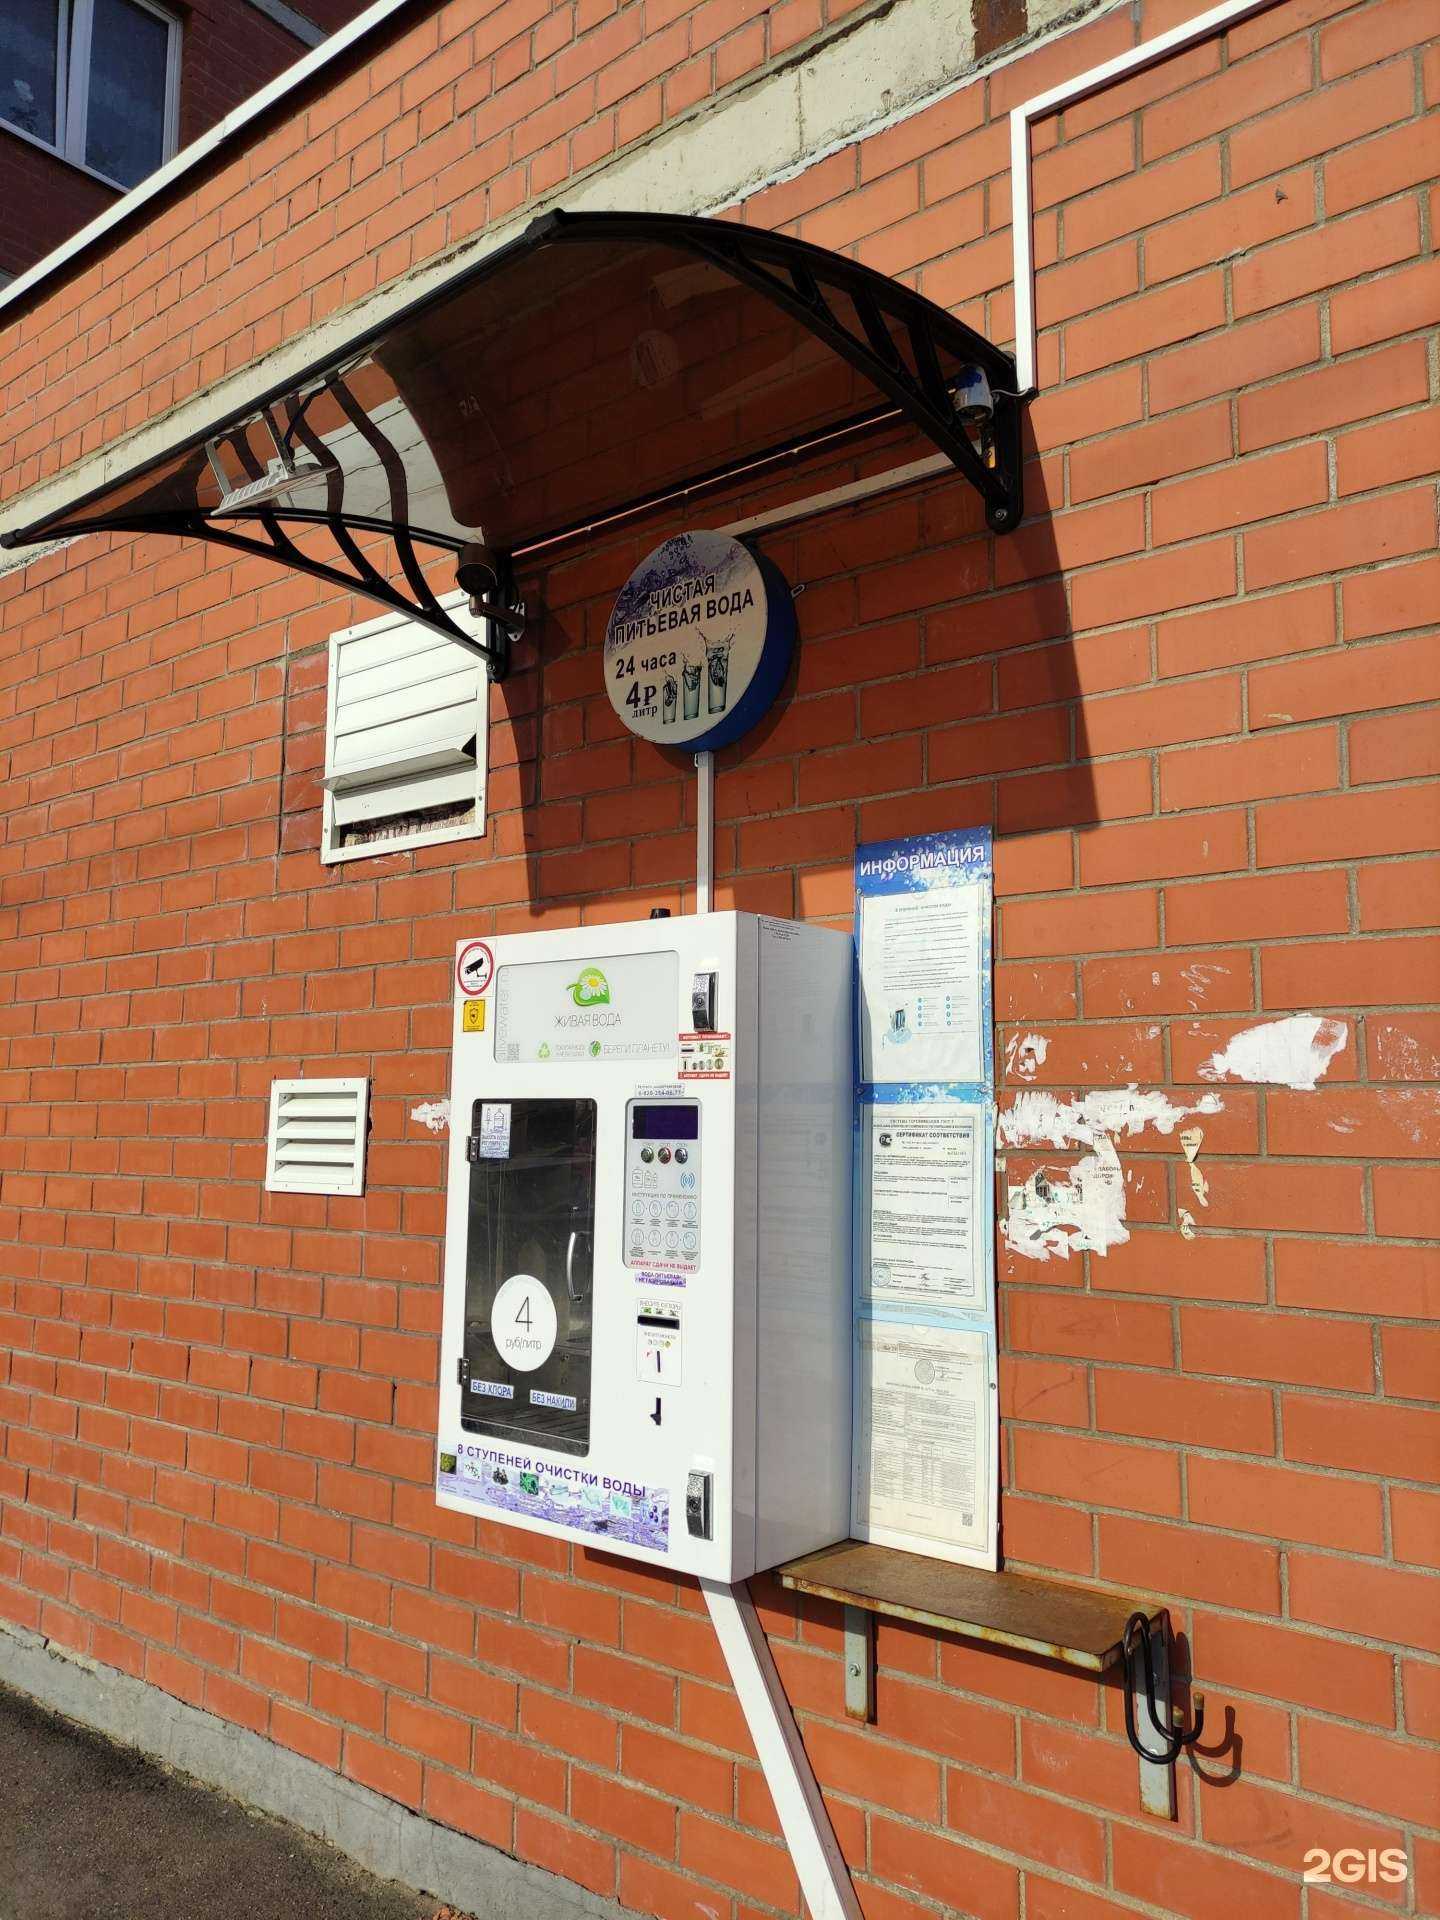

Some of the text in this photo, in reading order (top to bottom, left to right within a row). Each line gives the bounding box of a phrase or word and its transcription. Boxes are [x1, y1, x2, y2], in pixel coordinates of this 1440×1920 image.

[651, 575, 715, 610] ЧИСТАЯ
[614, 589, 754, 645] ПИТЬЕВАЯ ВОДА
[615, 652, 677, 679] 24 часа
[632, 705, 658, 718] литр
[860, 845, 985, 876] ИНФОРМАЦИЯ
[555, 1013, 622, 1028] ЖИВАЯ ВОДА
[515, 1296, 533, 1332] 4
[472, 1381, 512, 1397] БЕЗ ХЛОРА
[532, 1392, 575, 1408] БЕЗ НАКИПИ
[457, 1443, 646, 1498] 8 СТУПЕНЕЙ ОЧИСТКИ ВОДЫ
